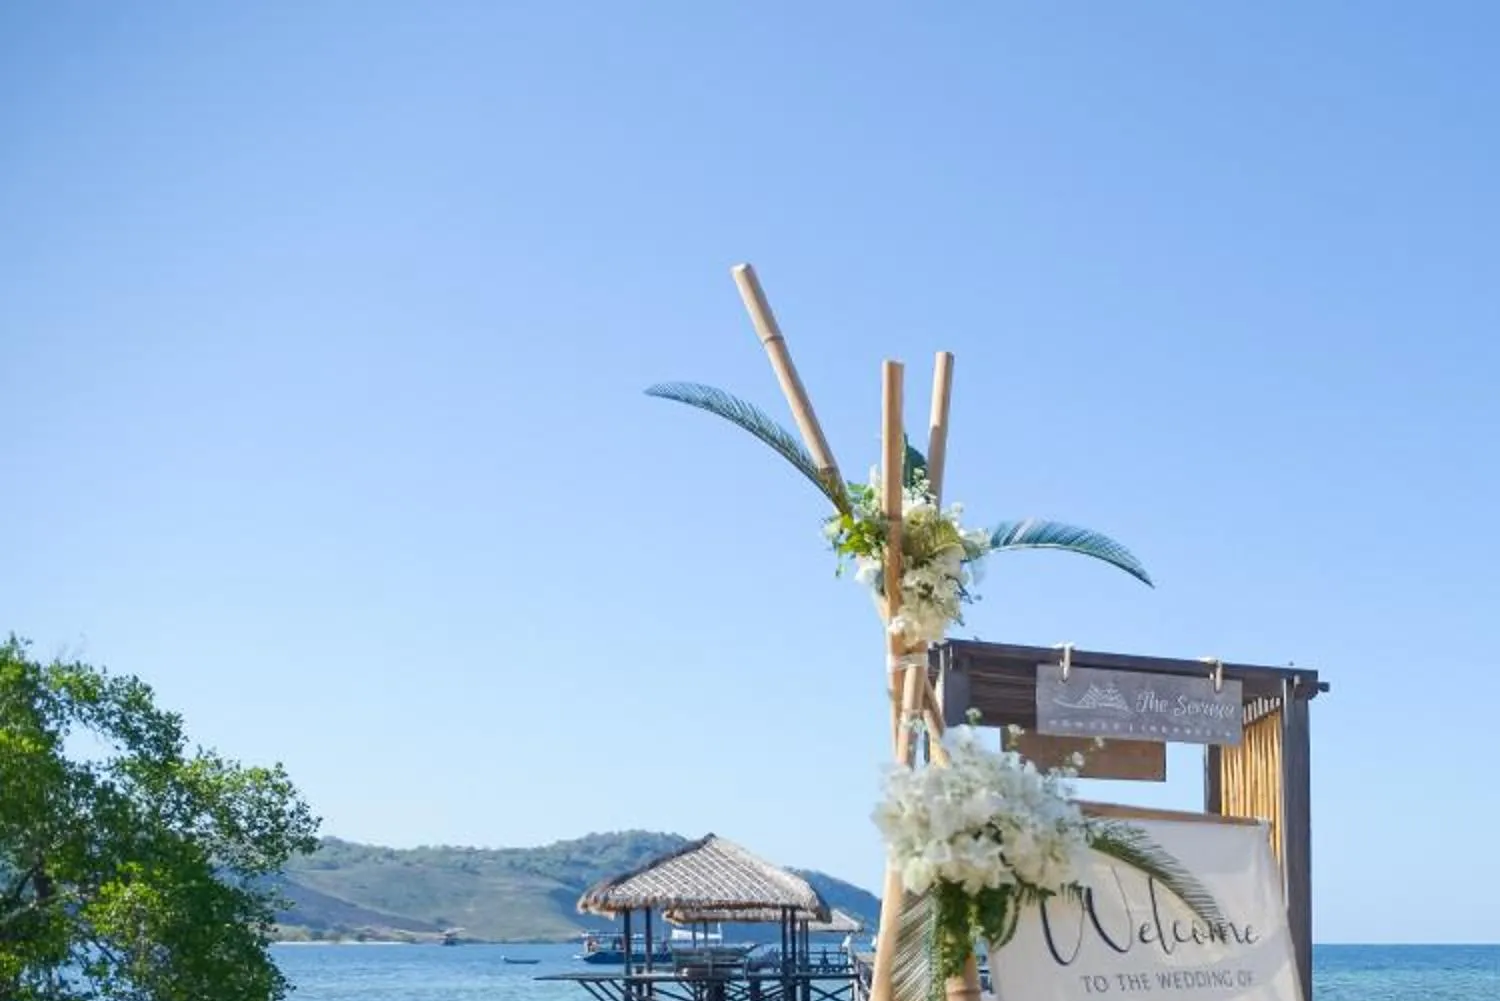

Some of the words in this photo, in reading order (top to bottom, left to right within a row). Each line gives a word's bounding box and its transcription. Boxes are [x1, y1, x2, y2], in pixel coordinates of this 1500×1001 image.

[1080, 975, 1109, 993] TO
[1116, 973, 1150, 991] THE
[1155, 969, 1233, 990] WEDDING
[1237, 970, 1256, 988] OF
